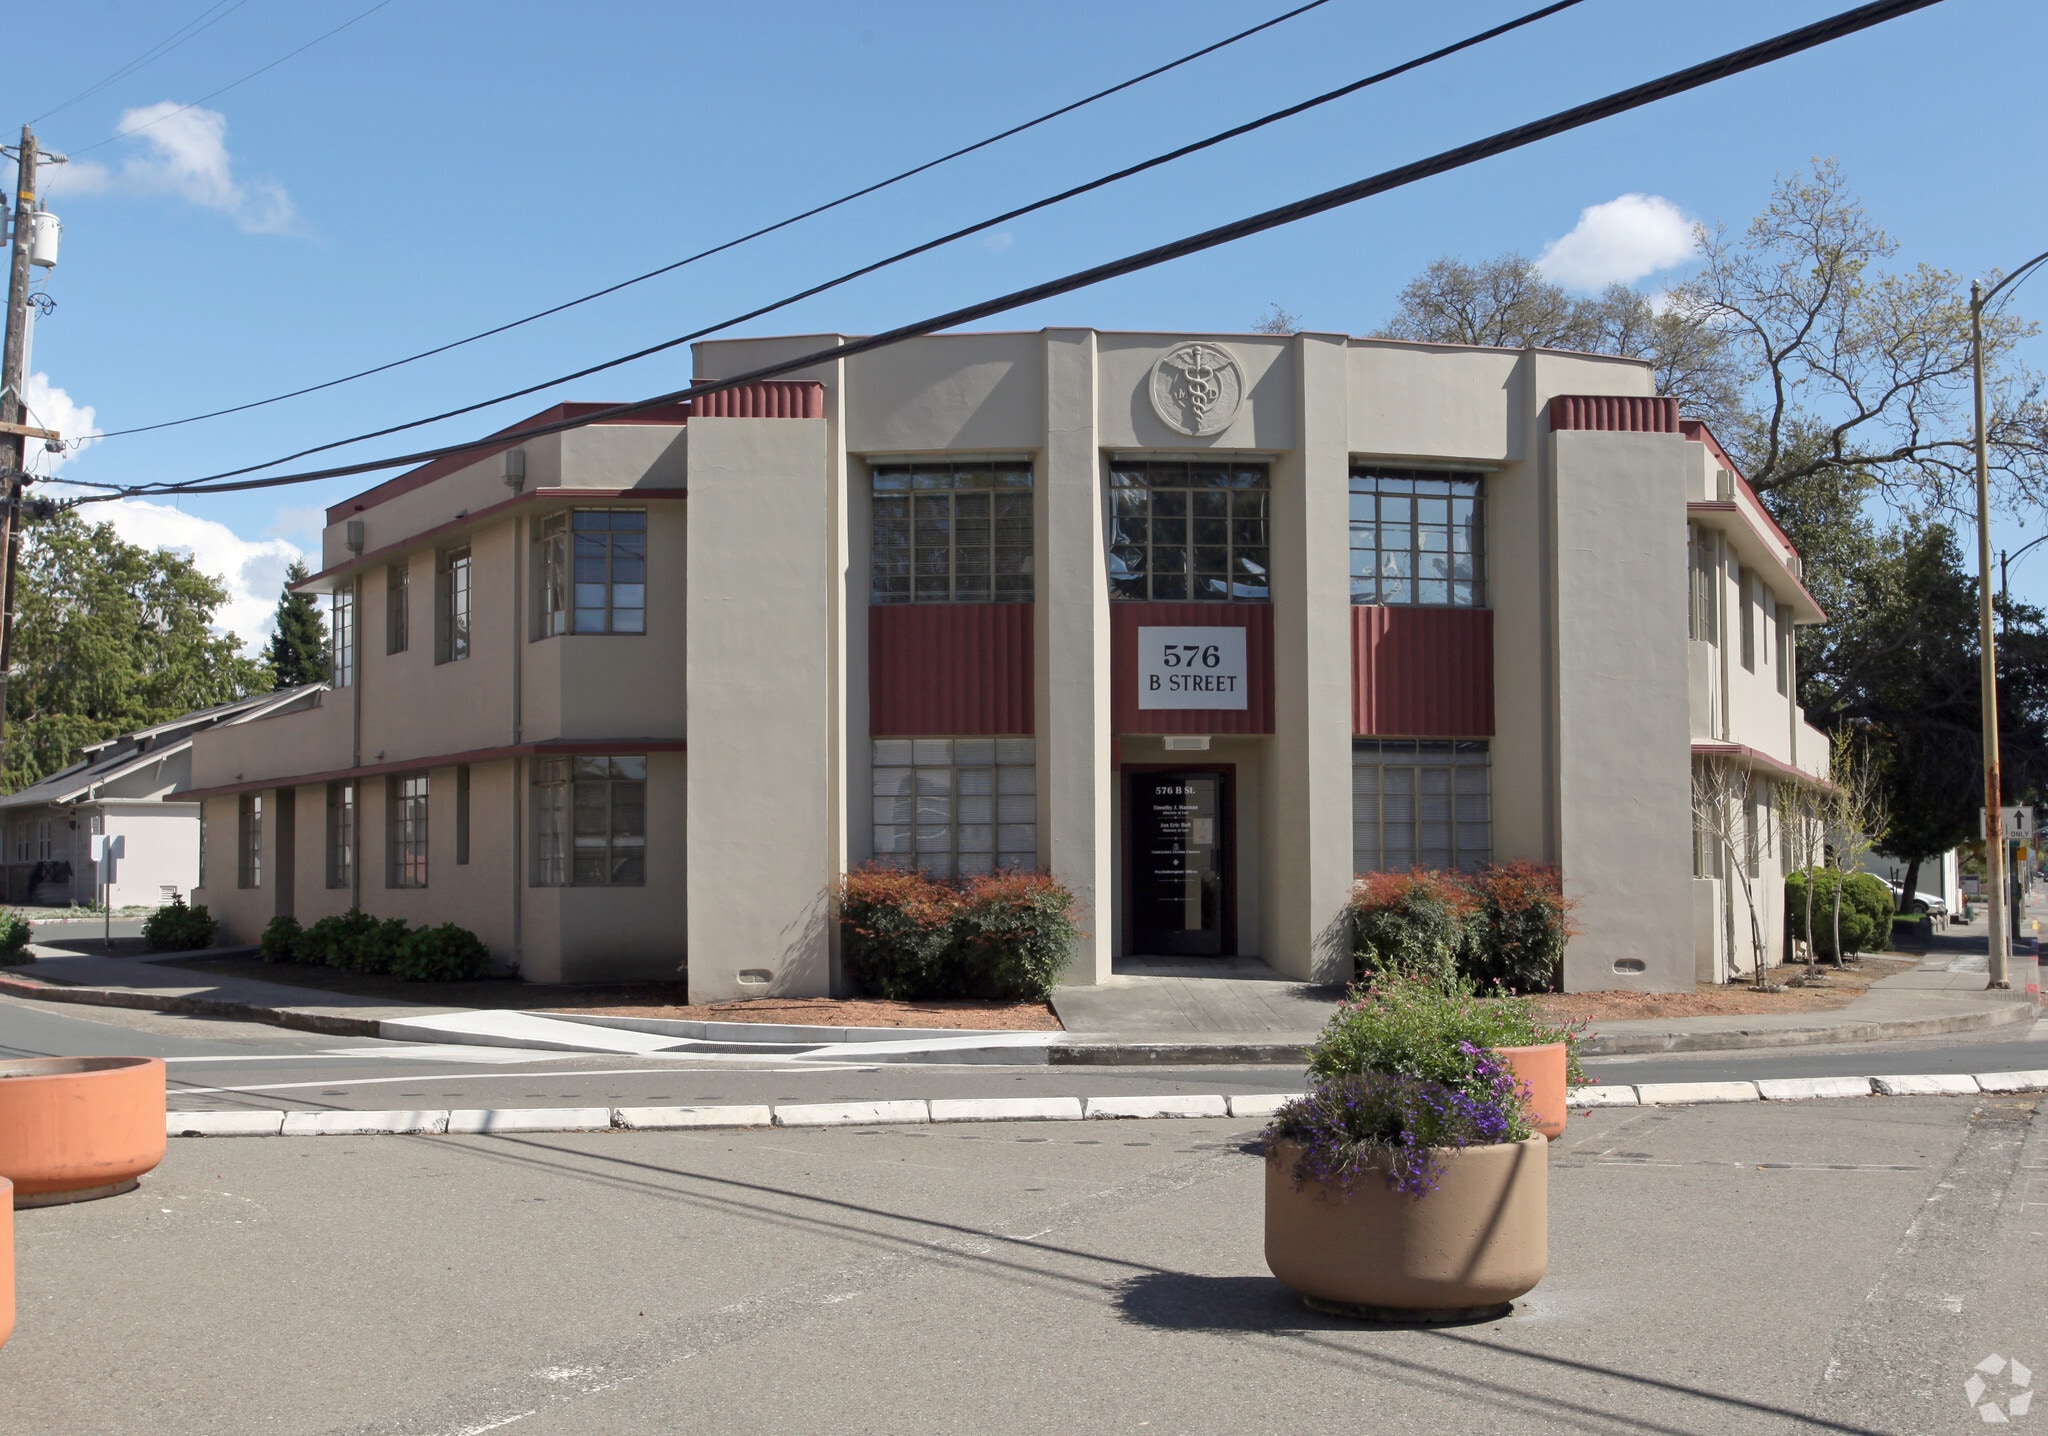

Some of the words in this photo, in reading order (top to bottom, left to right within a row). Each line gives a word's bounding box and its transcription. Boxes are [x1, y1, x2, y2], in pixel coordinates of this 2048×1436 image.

[1178, 388, 1188, 399] M
[1209, 389, 1218, 399] D
[1163, 644, 1221, 668] 576
[1149, 674, 1162, 691] B
[1169, 674, 1238, 692] STREET
[1155, 786, 1173, 795] 576
[1175, 786, 1182, 795] B
[1184, 786, 1196, 795] St.
